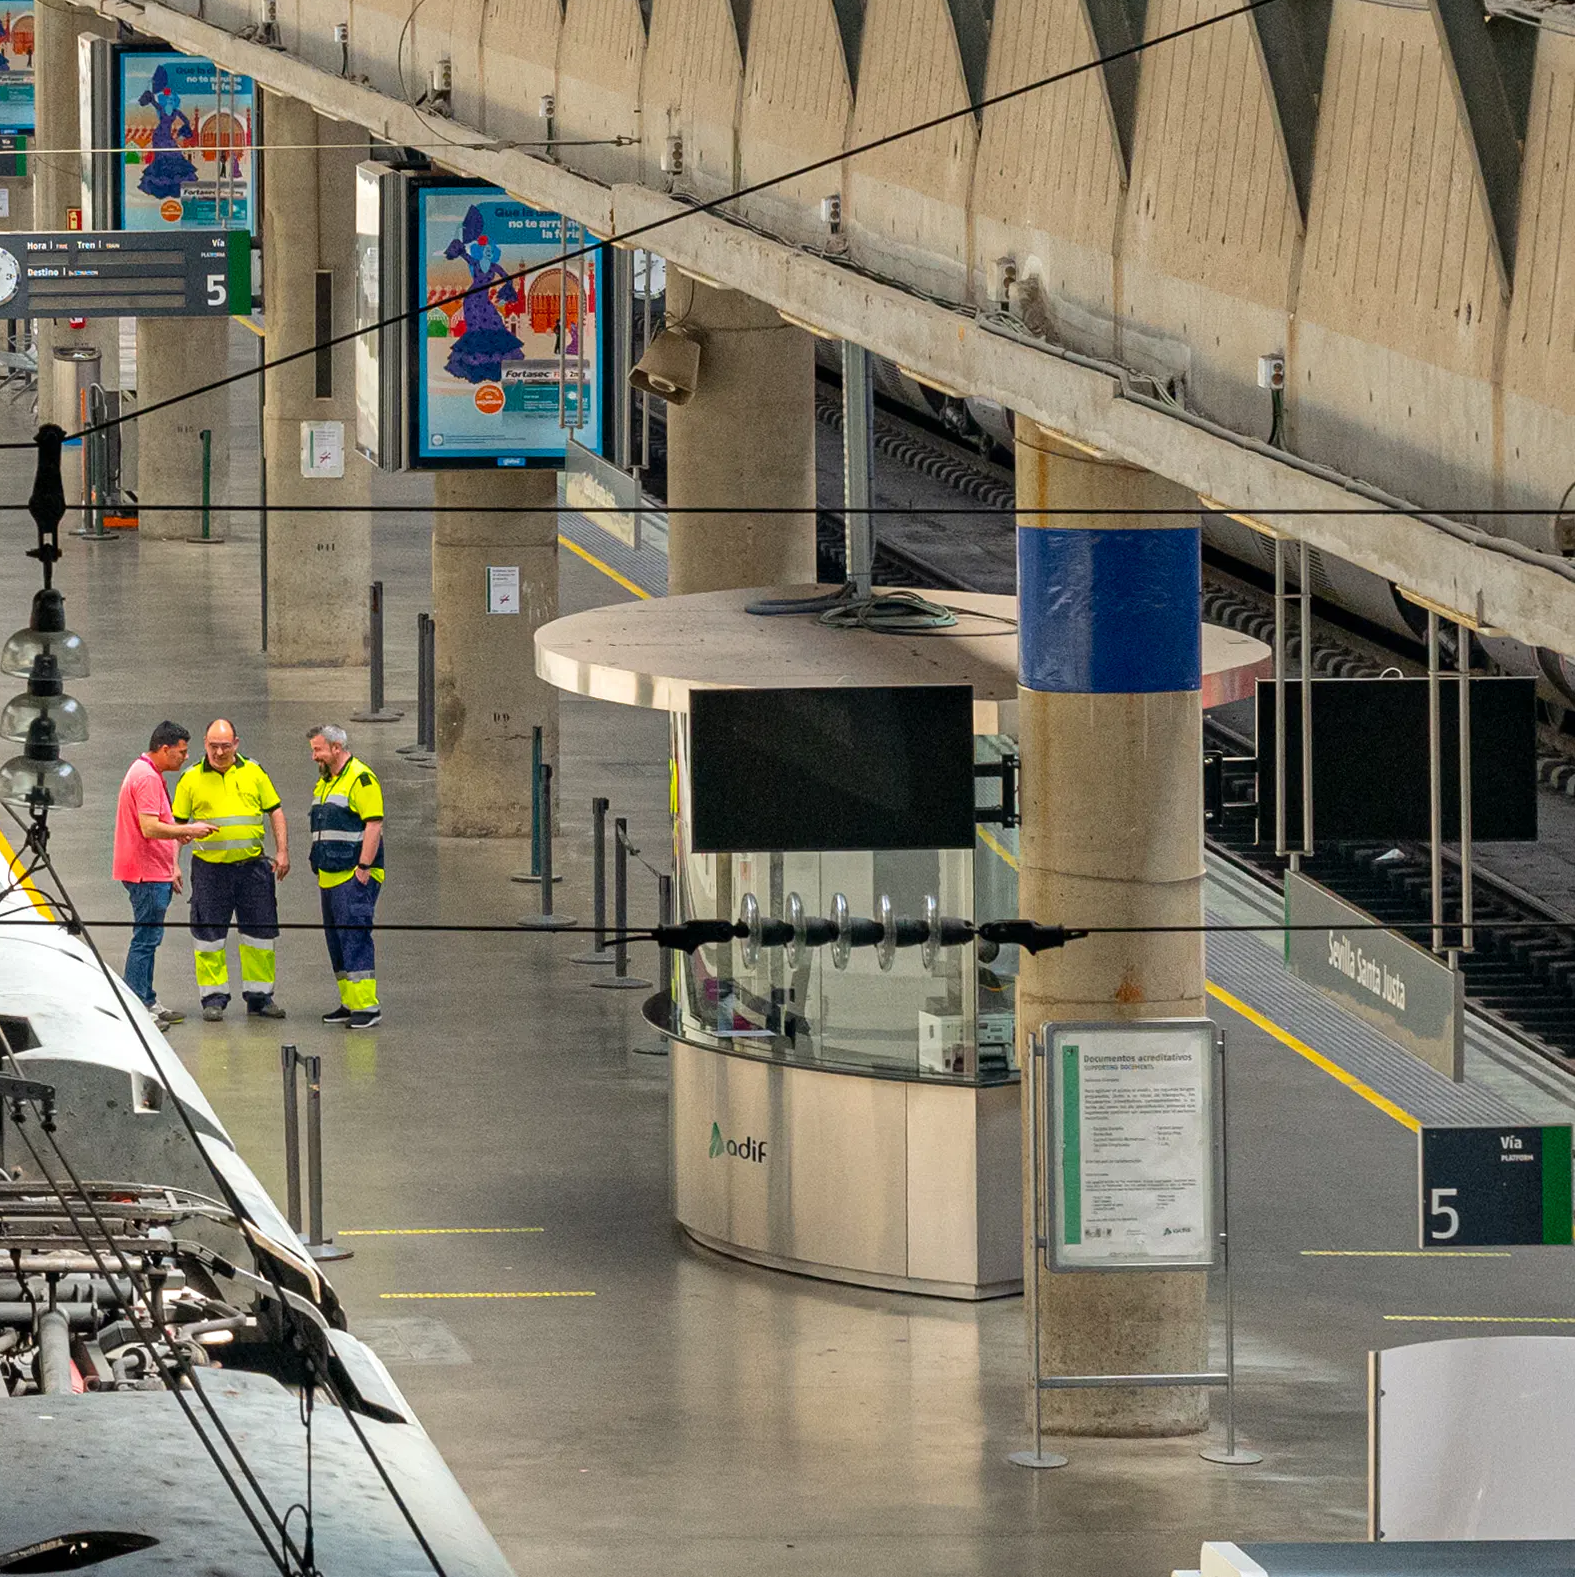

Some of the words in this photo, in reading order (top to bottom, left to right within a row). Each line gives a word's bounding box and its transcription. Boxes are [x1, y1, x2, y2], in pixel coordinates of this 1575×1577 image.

[495, 207, 520, 217] Que
[522, 207, 534, 217] la
[508, 220, 523, 229] no
[525, 219, 538, 228] te
[542, 229, 552, 239] la
[27, 241, 46, 250] Hora
[77, 241, 95, 249] Tren
[212, 238, 225, 247] Vía
[27, 268, 59, 276] Destino
[207, 274, 226, 306] 5
[506, 370, 550, 378] Fortasec
[1328, 929, 1355, 979] Sevilla
[1357, 947, 1381, 995] Santa
[1382, 964, 1406, 1011] Justa
[1083, 1054, 1135, 1063] Documentos
[1138, 1053, 1192, 1062] acreditativos
[1500, 1135, 1523, 1149] Vía
[726, 1136, 768, 1163] adif
[1501, 1154, 1534, 1162] PLATFORM
[1431, 1188, 1460, 1240] 5
